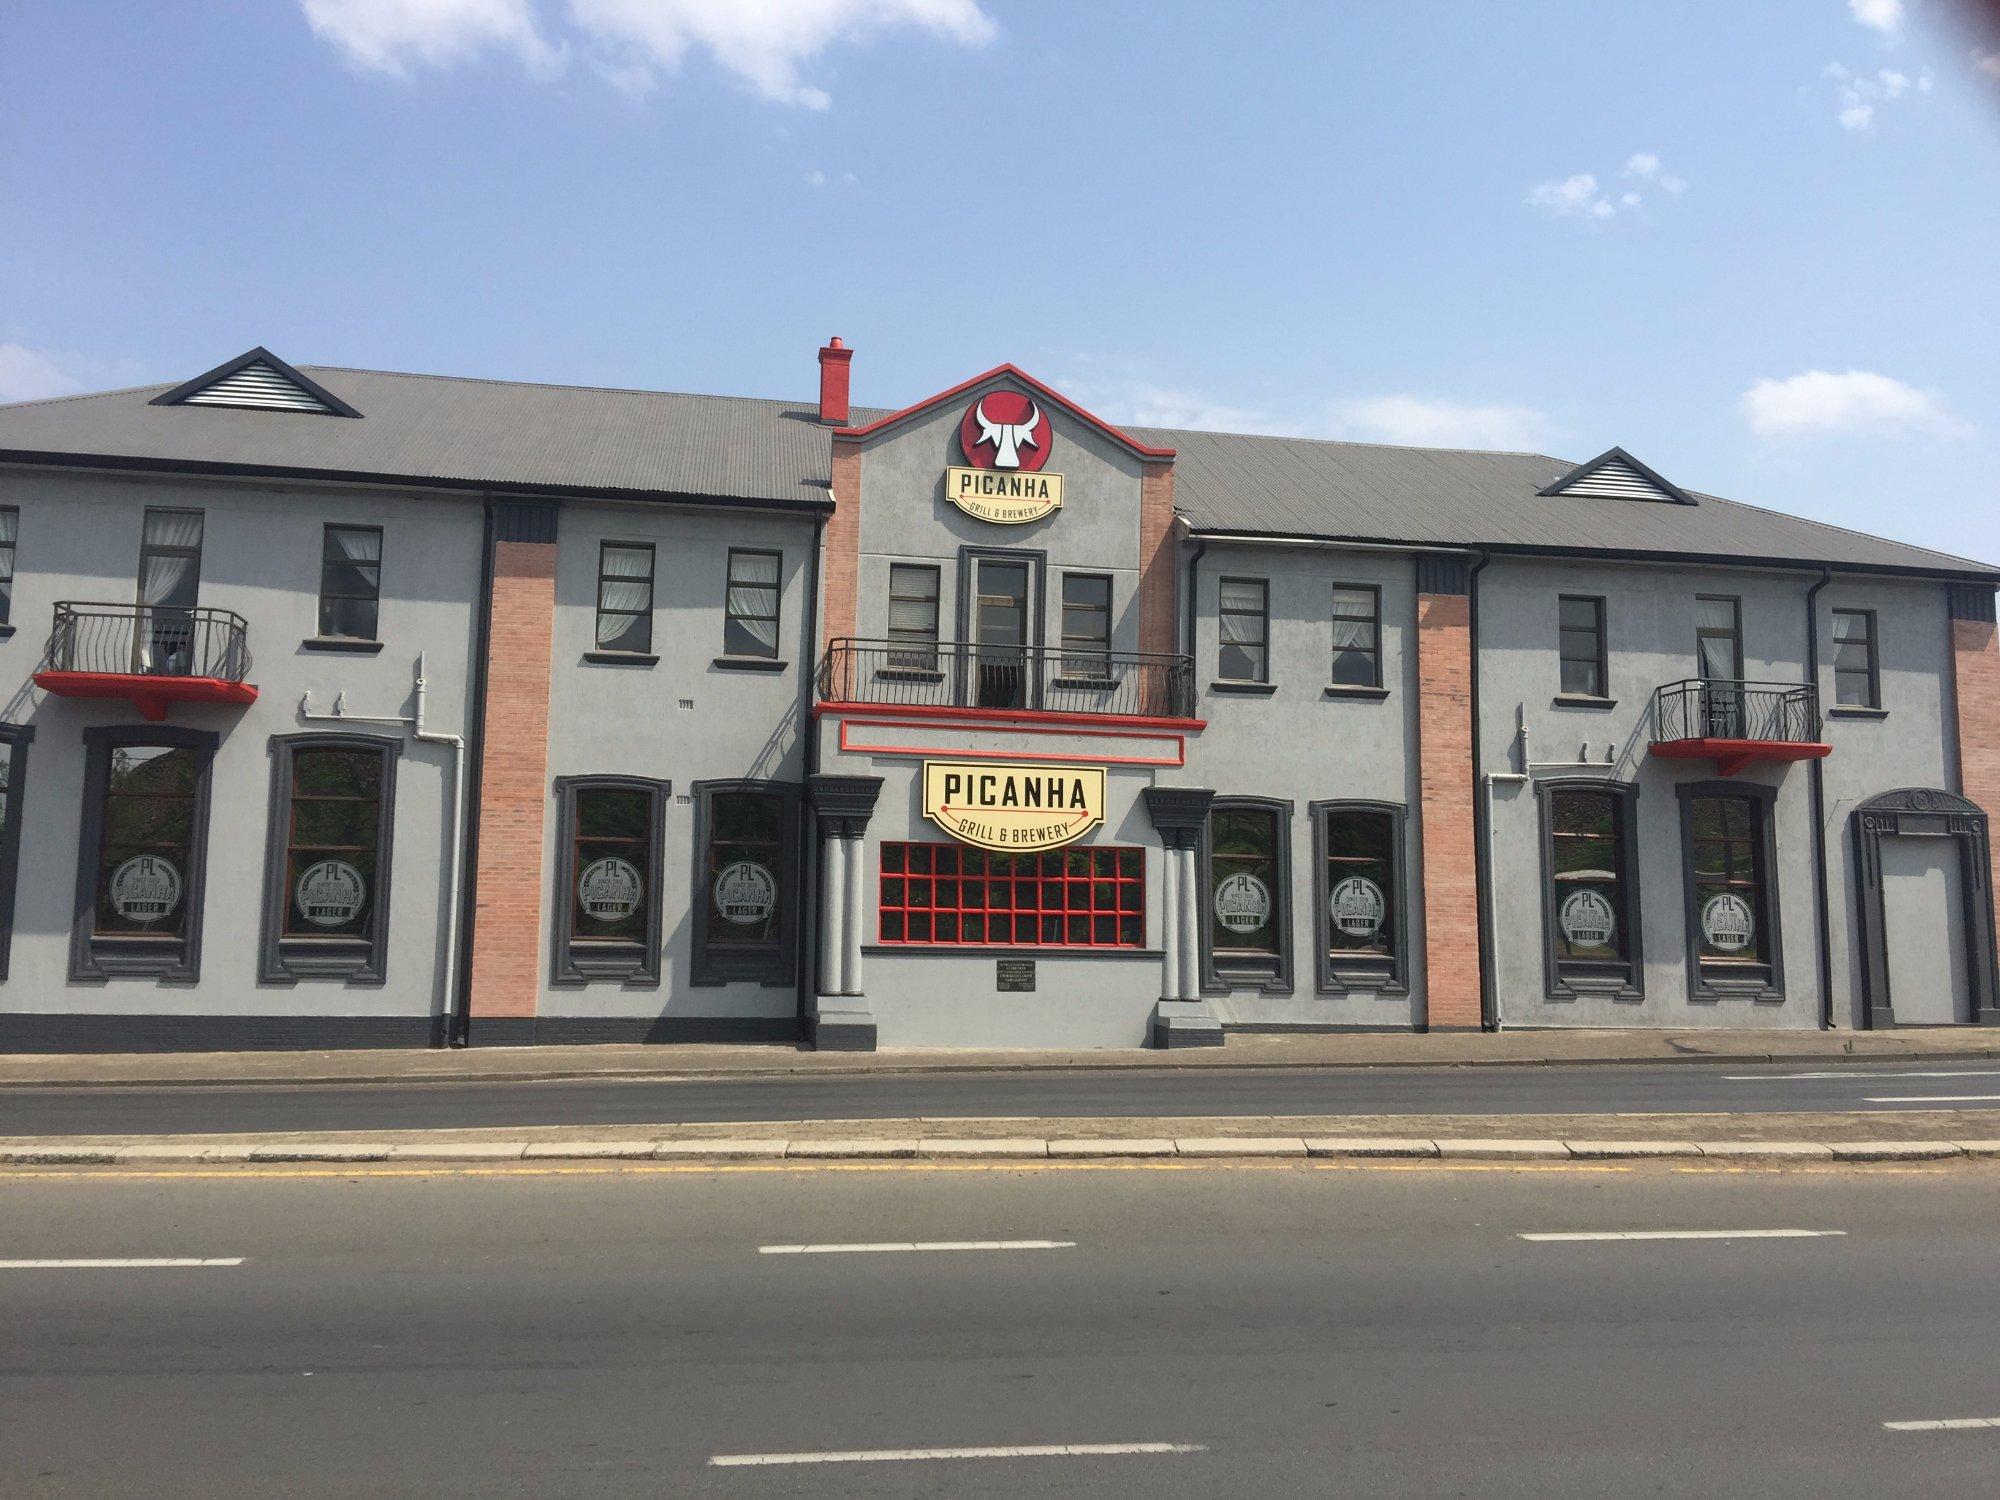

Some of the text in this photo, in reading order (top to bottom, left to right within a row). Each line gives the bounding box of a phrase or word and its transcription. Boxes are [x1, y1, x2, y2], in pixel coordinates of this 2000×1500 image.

[960, 473, 1049, 499] PICANHA
[969, 501, 1038, 519] GRILL & BREWERY
[944, 773, 1087, 809] PICANHA
[958, 818, 1070, 843] GRILL & BREWERY
[141, 858, 156, 876] PL
[326, 863, 341, 881] PL
[605, 860, 620, 877] PL
[740, 865, 754, 881] PL
[1237, 876, 1250, 892] PL
[1352, 879, 1365, 895] PL
[301, 889, 359, 906] PICANHA
[584, 885, 636, 902] PICANHA
[720, 889, 769, 905] PICANHA
[1582, 892, 1594, 908] PL
[130, 902, 159, 911] LAGER
[597, 902, 623, 911] LAGER
[733, 906, 758, 915] LAGER
[1220, 900, 1265, 915] PICANHA
[1334, 903, 1381, 918] PICANHA
[1722, 896, 1734, 911] PL
[315, 907, 343, 917] LAGER
[1231, 916, 1255, 925] LAGER
[1347, 919, 1369, 928] LAGER
[1565, 914, 1610, 930] PICANHA
[1707, 918, 1750, 933] PICANHA
[1577, 930, 1600, 940] LAGER
[1717, 934, 1739, 943] LAGER
